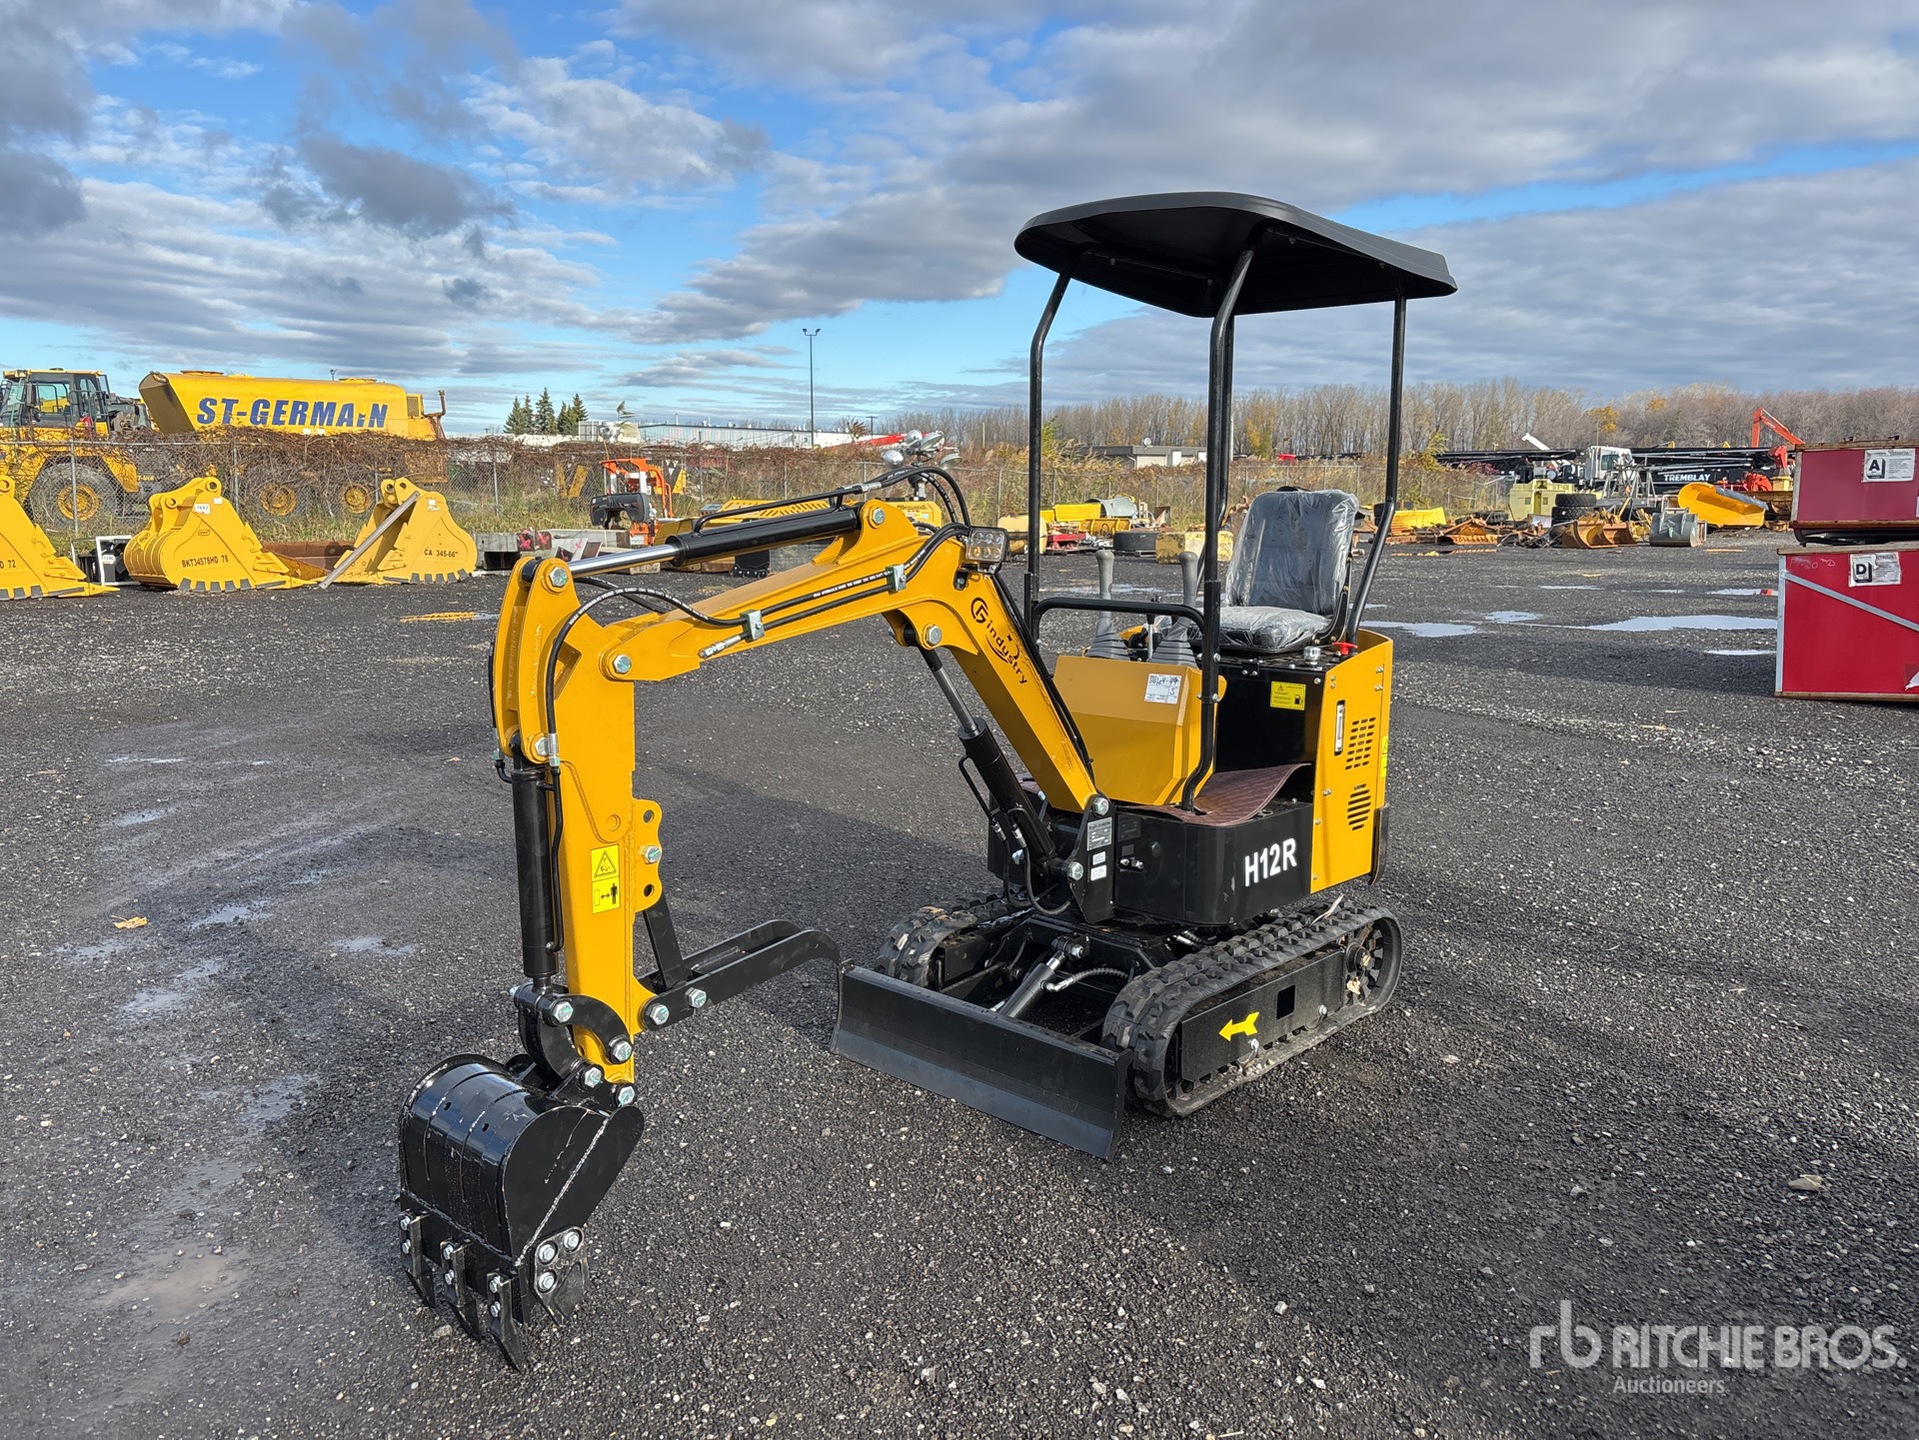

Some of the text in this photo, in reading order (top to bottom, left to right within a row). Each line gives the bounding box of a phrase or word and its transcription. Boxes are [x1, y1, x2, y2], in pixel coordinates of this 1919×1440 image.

[1869, 459, 1881, 471] A
[1664, 474, 1711, 482] TREMBLAY
[7, 559, 16, 568] 72
[1856, 564, 1867, 575] D
[1245, 838, 1298, 887] H12R
